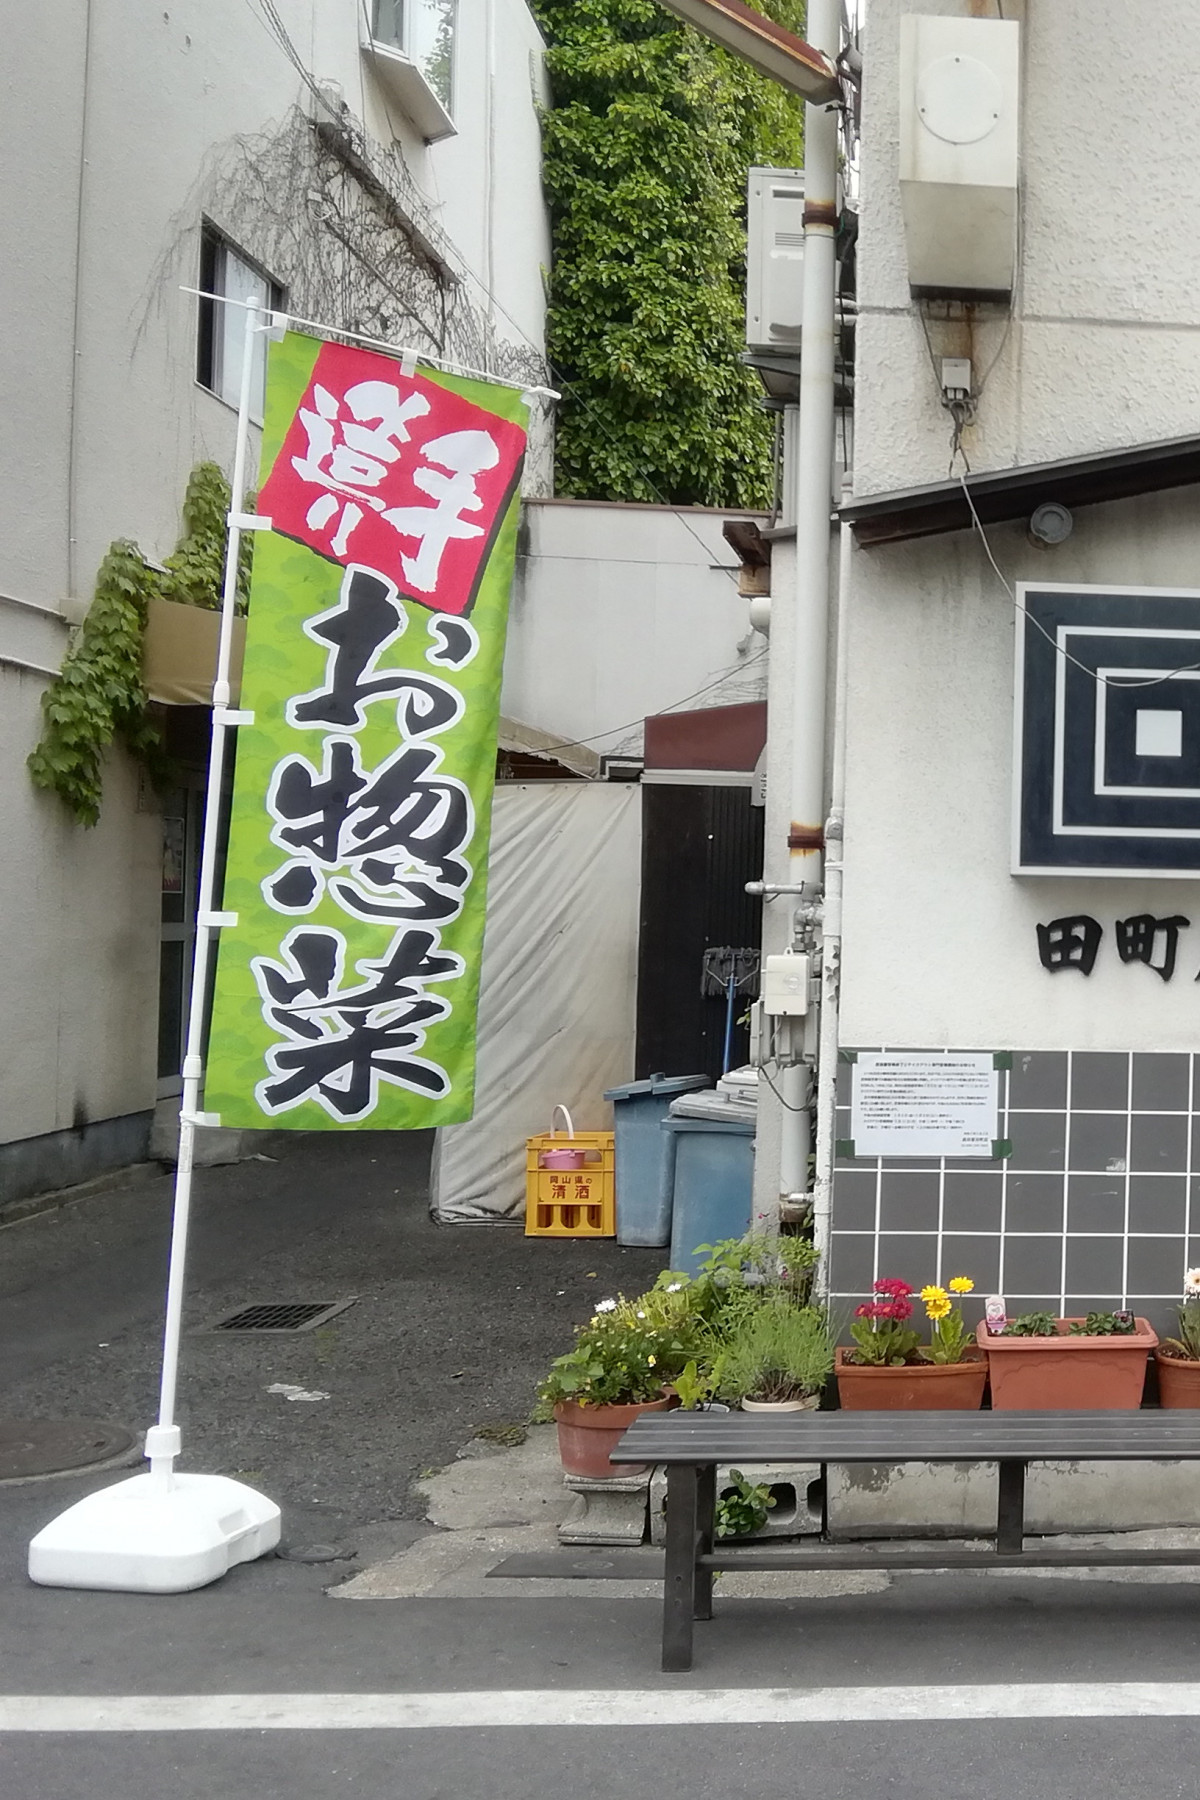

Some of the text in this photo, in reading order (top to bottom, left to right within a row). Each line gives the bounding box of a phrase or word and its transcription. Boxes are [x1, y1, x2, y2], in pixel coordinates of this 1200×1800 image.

[252, 565, 478, 1122] お惣菜
[550, 1176, 593, 1185] 岡山県の
[552, 1185, 590, 1199] 清酒
